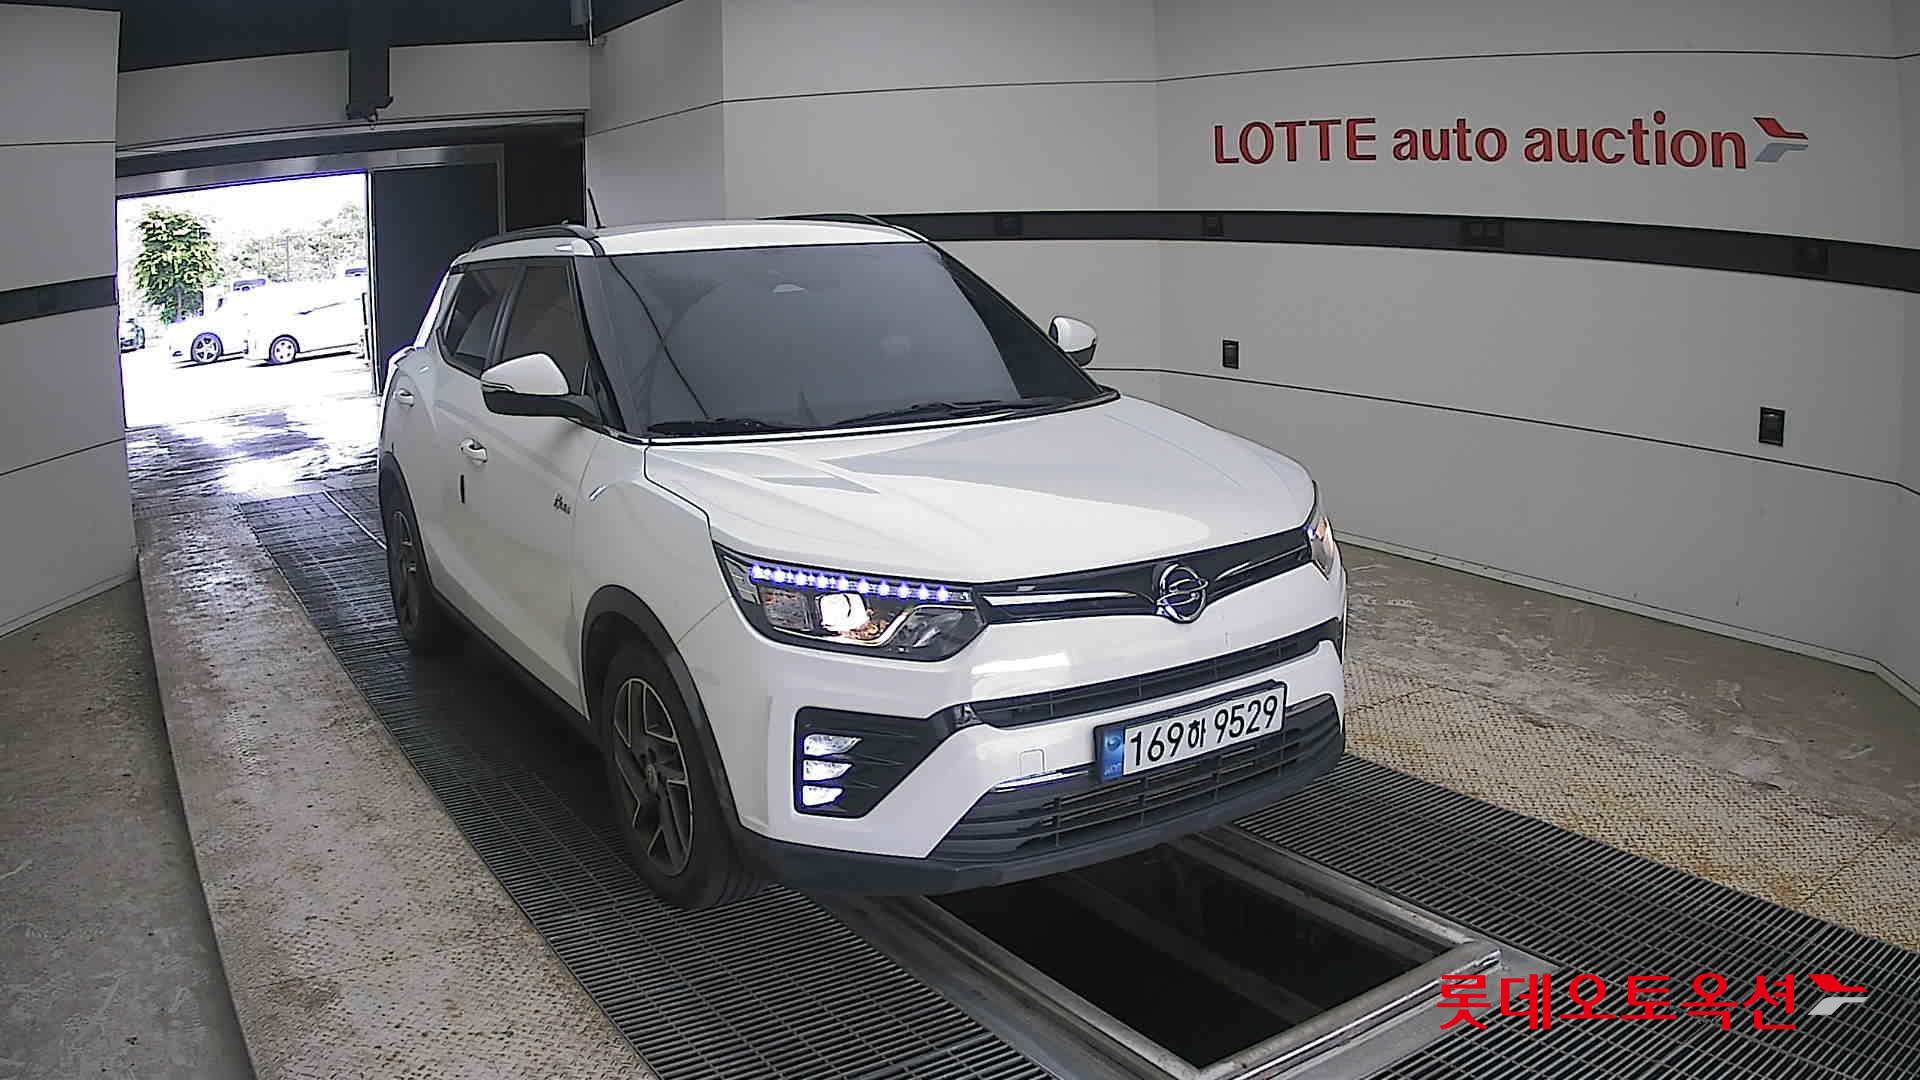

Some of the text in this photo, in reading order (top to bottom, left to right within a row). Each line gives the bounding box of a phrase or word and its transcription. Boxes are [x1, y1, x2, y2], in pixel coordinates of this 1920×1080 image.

[1213, 110, 1746, 169] LOTTE auto auction
[1214, 695, 1278, 744] 9529
